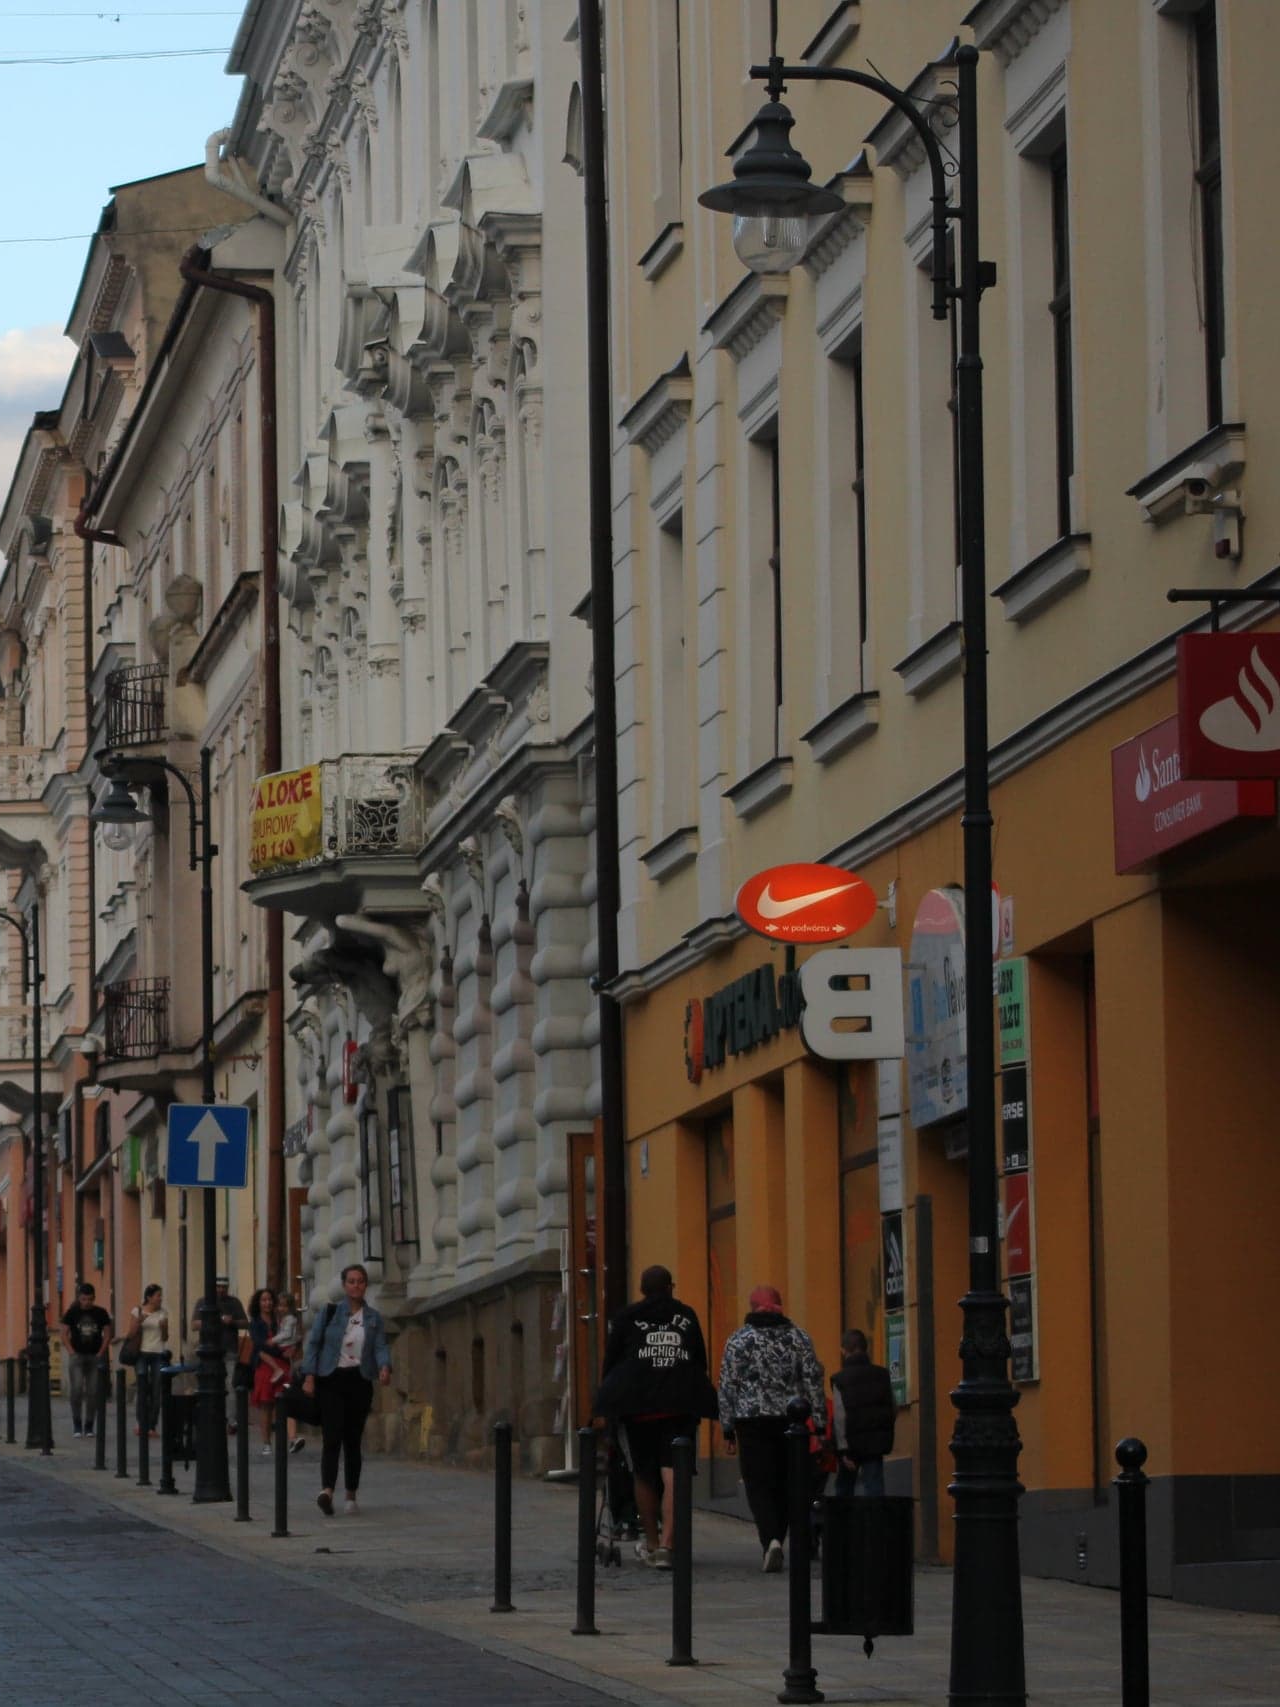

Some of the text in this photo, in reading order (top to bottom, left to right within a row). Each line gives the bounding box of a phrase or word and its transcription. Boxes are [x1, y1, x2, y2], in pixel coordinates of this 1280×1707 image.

[791, 923, 830, 934] podwórzu
[638, 1345, 689, 1360] MICHIGAN
[652, 1357, 676, 1368] 1977
